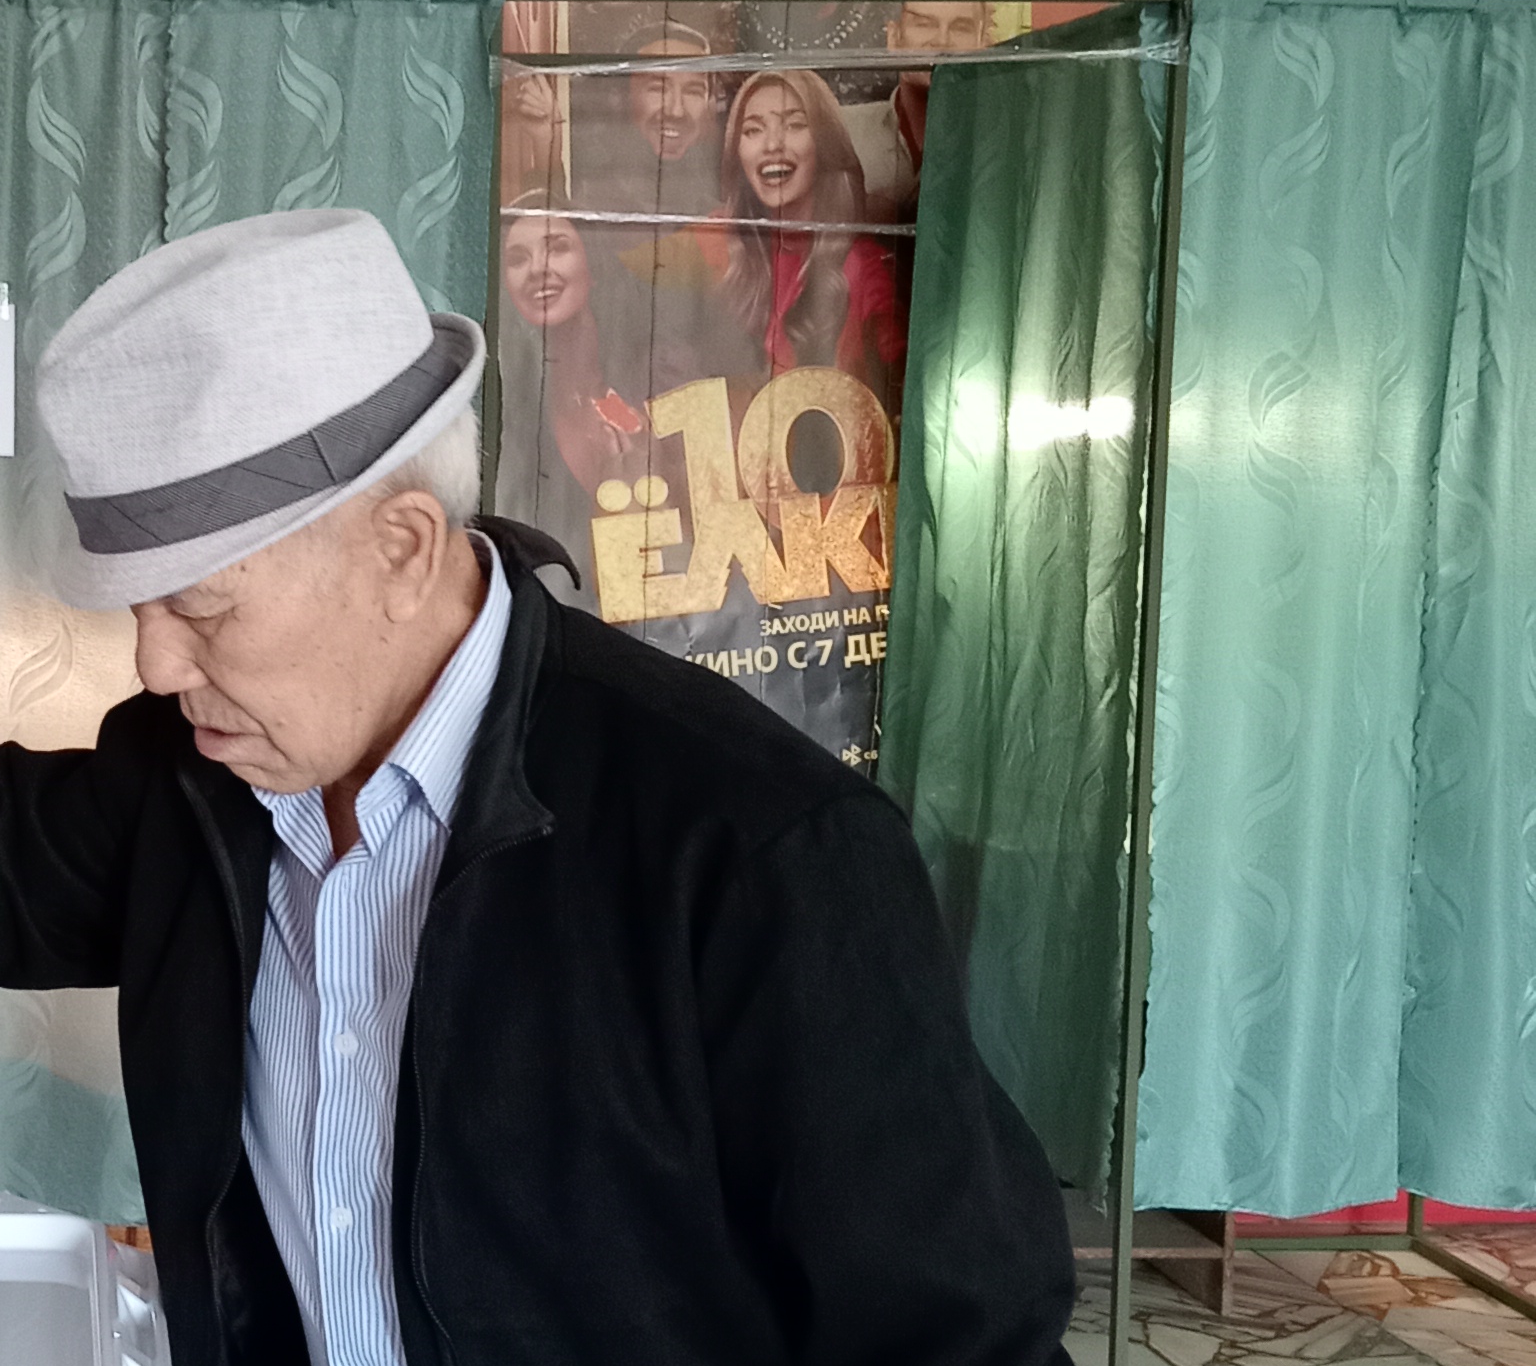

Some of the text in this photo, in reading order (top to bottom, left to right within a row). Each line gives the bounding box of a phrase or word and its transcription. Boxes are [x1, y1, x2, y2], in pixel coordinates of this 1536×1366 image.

[644, 365, 895, 532] 10
[590, 475, 899, 624] ЁЛК
[760, 610, 839, 637] ЗАХОДИ
[843, 605, 872, 626] НА
[787, 641, 808, 669] С
[815, 638, 834, 666] 7
